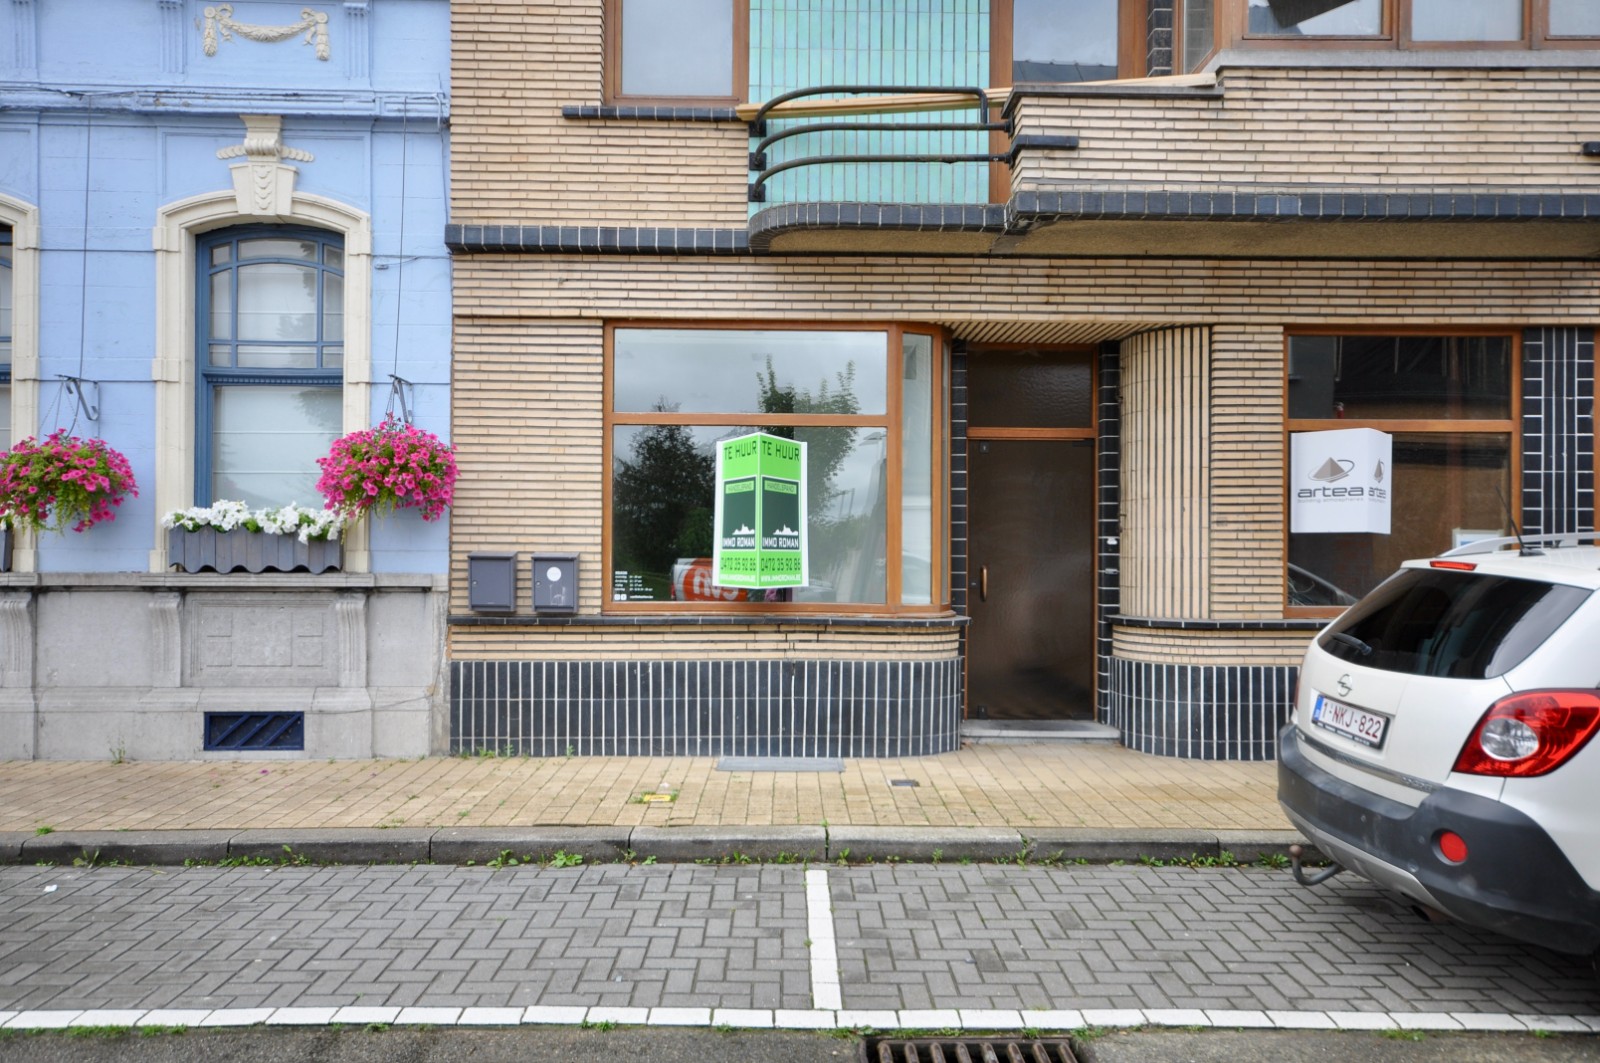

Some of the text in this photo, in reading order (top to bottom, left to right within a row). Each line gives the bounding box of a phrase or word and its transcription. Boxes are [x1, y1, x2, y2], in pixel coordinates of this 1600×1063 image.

[724, 440, 757, 460] TE HUUR
[762, 440, 800, 462] TE HUUR
[1297, 486, 1364, 498] artea
[723, 537, 755, 547] IMMO ROMAN
[762, 537, 799, 548] IMMO ROMAN
[761, 557, 776, 572] 0472
[777, 557, 784, 571] 35
[785, 557, 793, 571] 92
[1322, 702, 1382, 739] 1-NKJ-822
